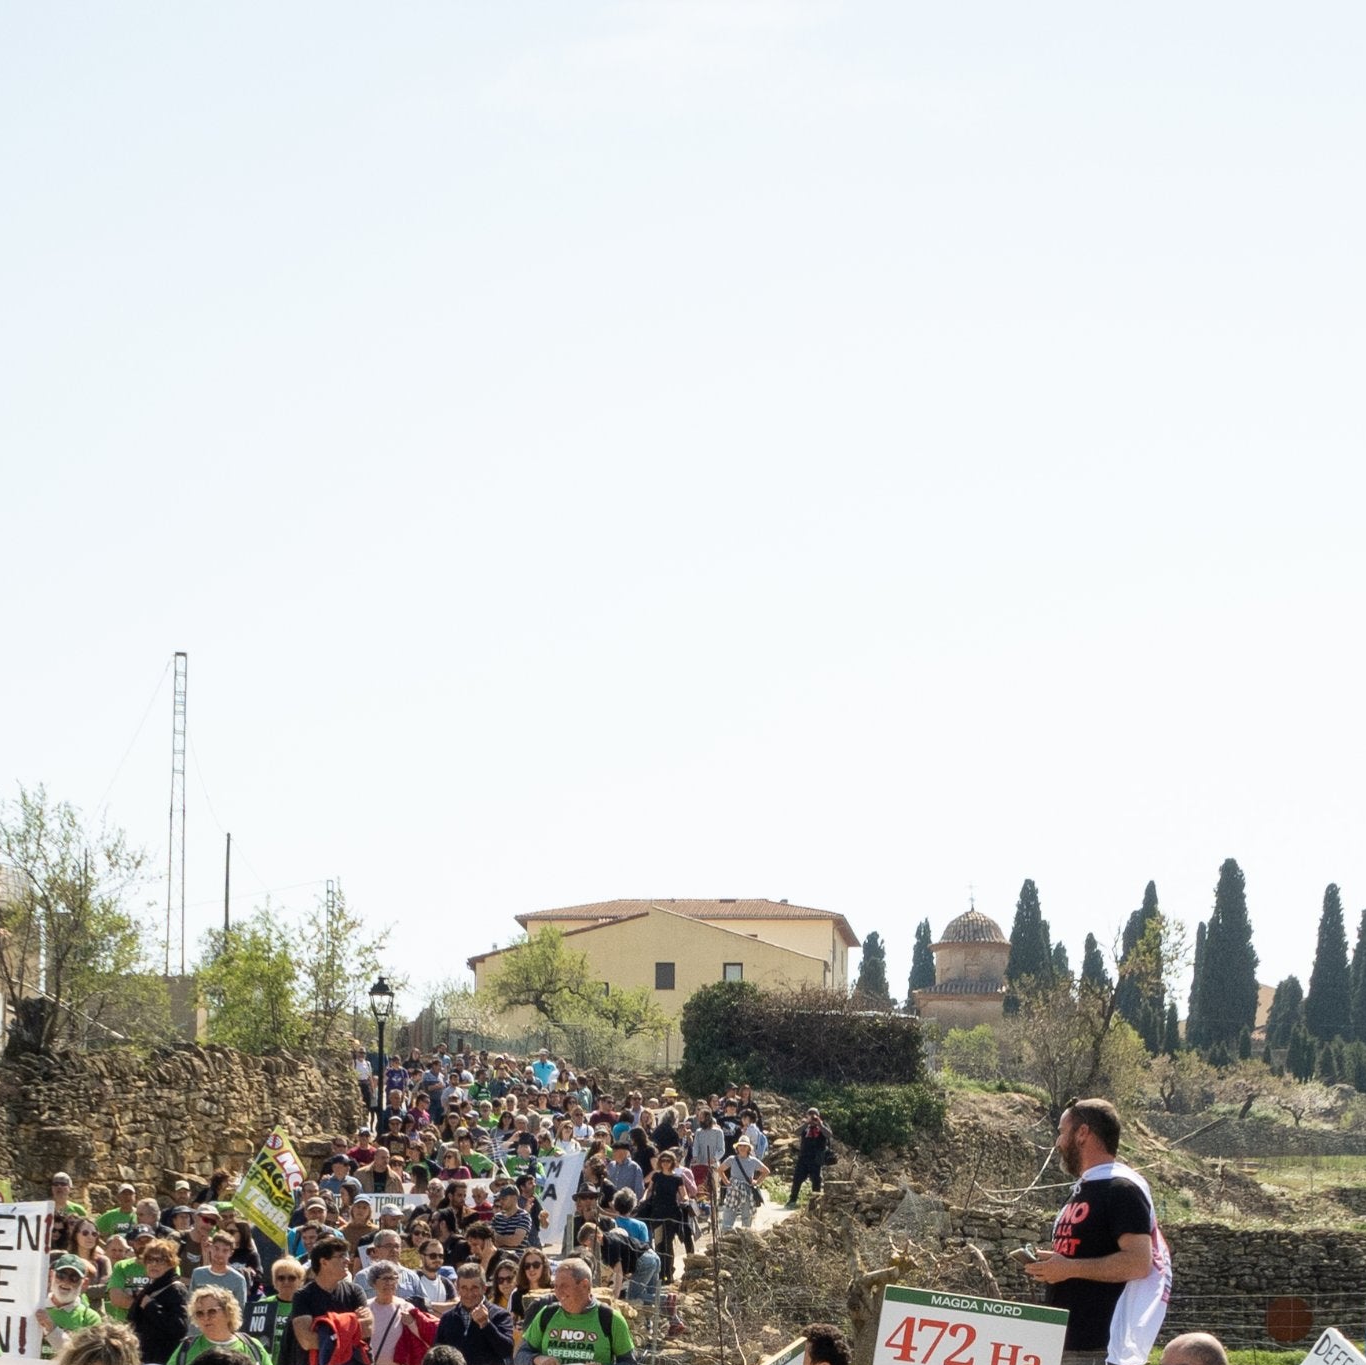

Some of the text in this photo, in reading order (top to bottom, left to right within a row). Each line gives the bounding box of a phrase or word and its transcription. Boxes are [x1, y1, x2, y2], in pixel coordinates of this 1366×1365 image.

[1059, 1202, 1090, 1224] NO
[931, 1294, 1023, 1317] MAGDA NORD
[249, 1316, 266, 1333] NO
[561, 1330, 585, 1340] NO
[547, 1349, 595, 1360] DEFENSEM
